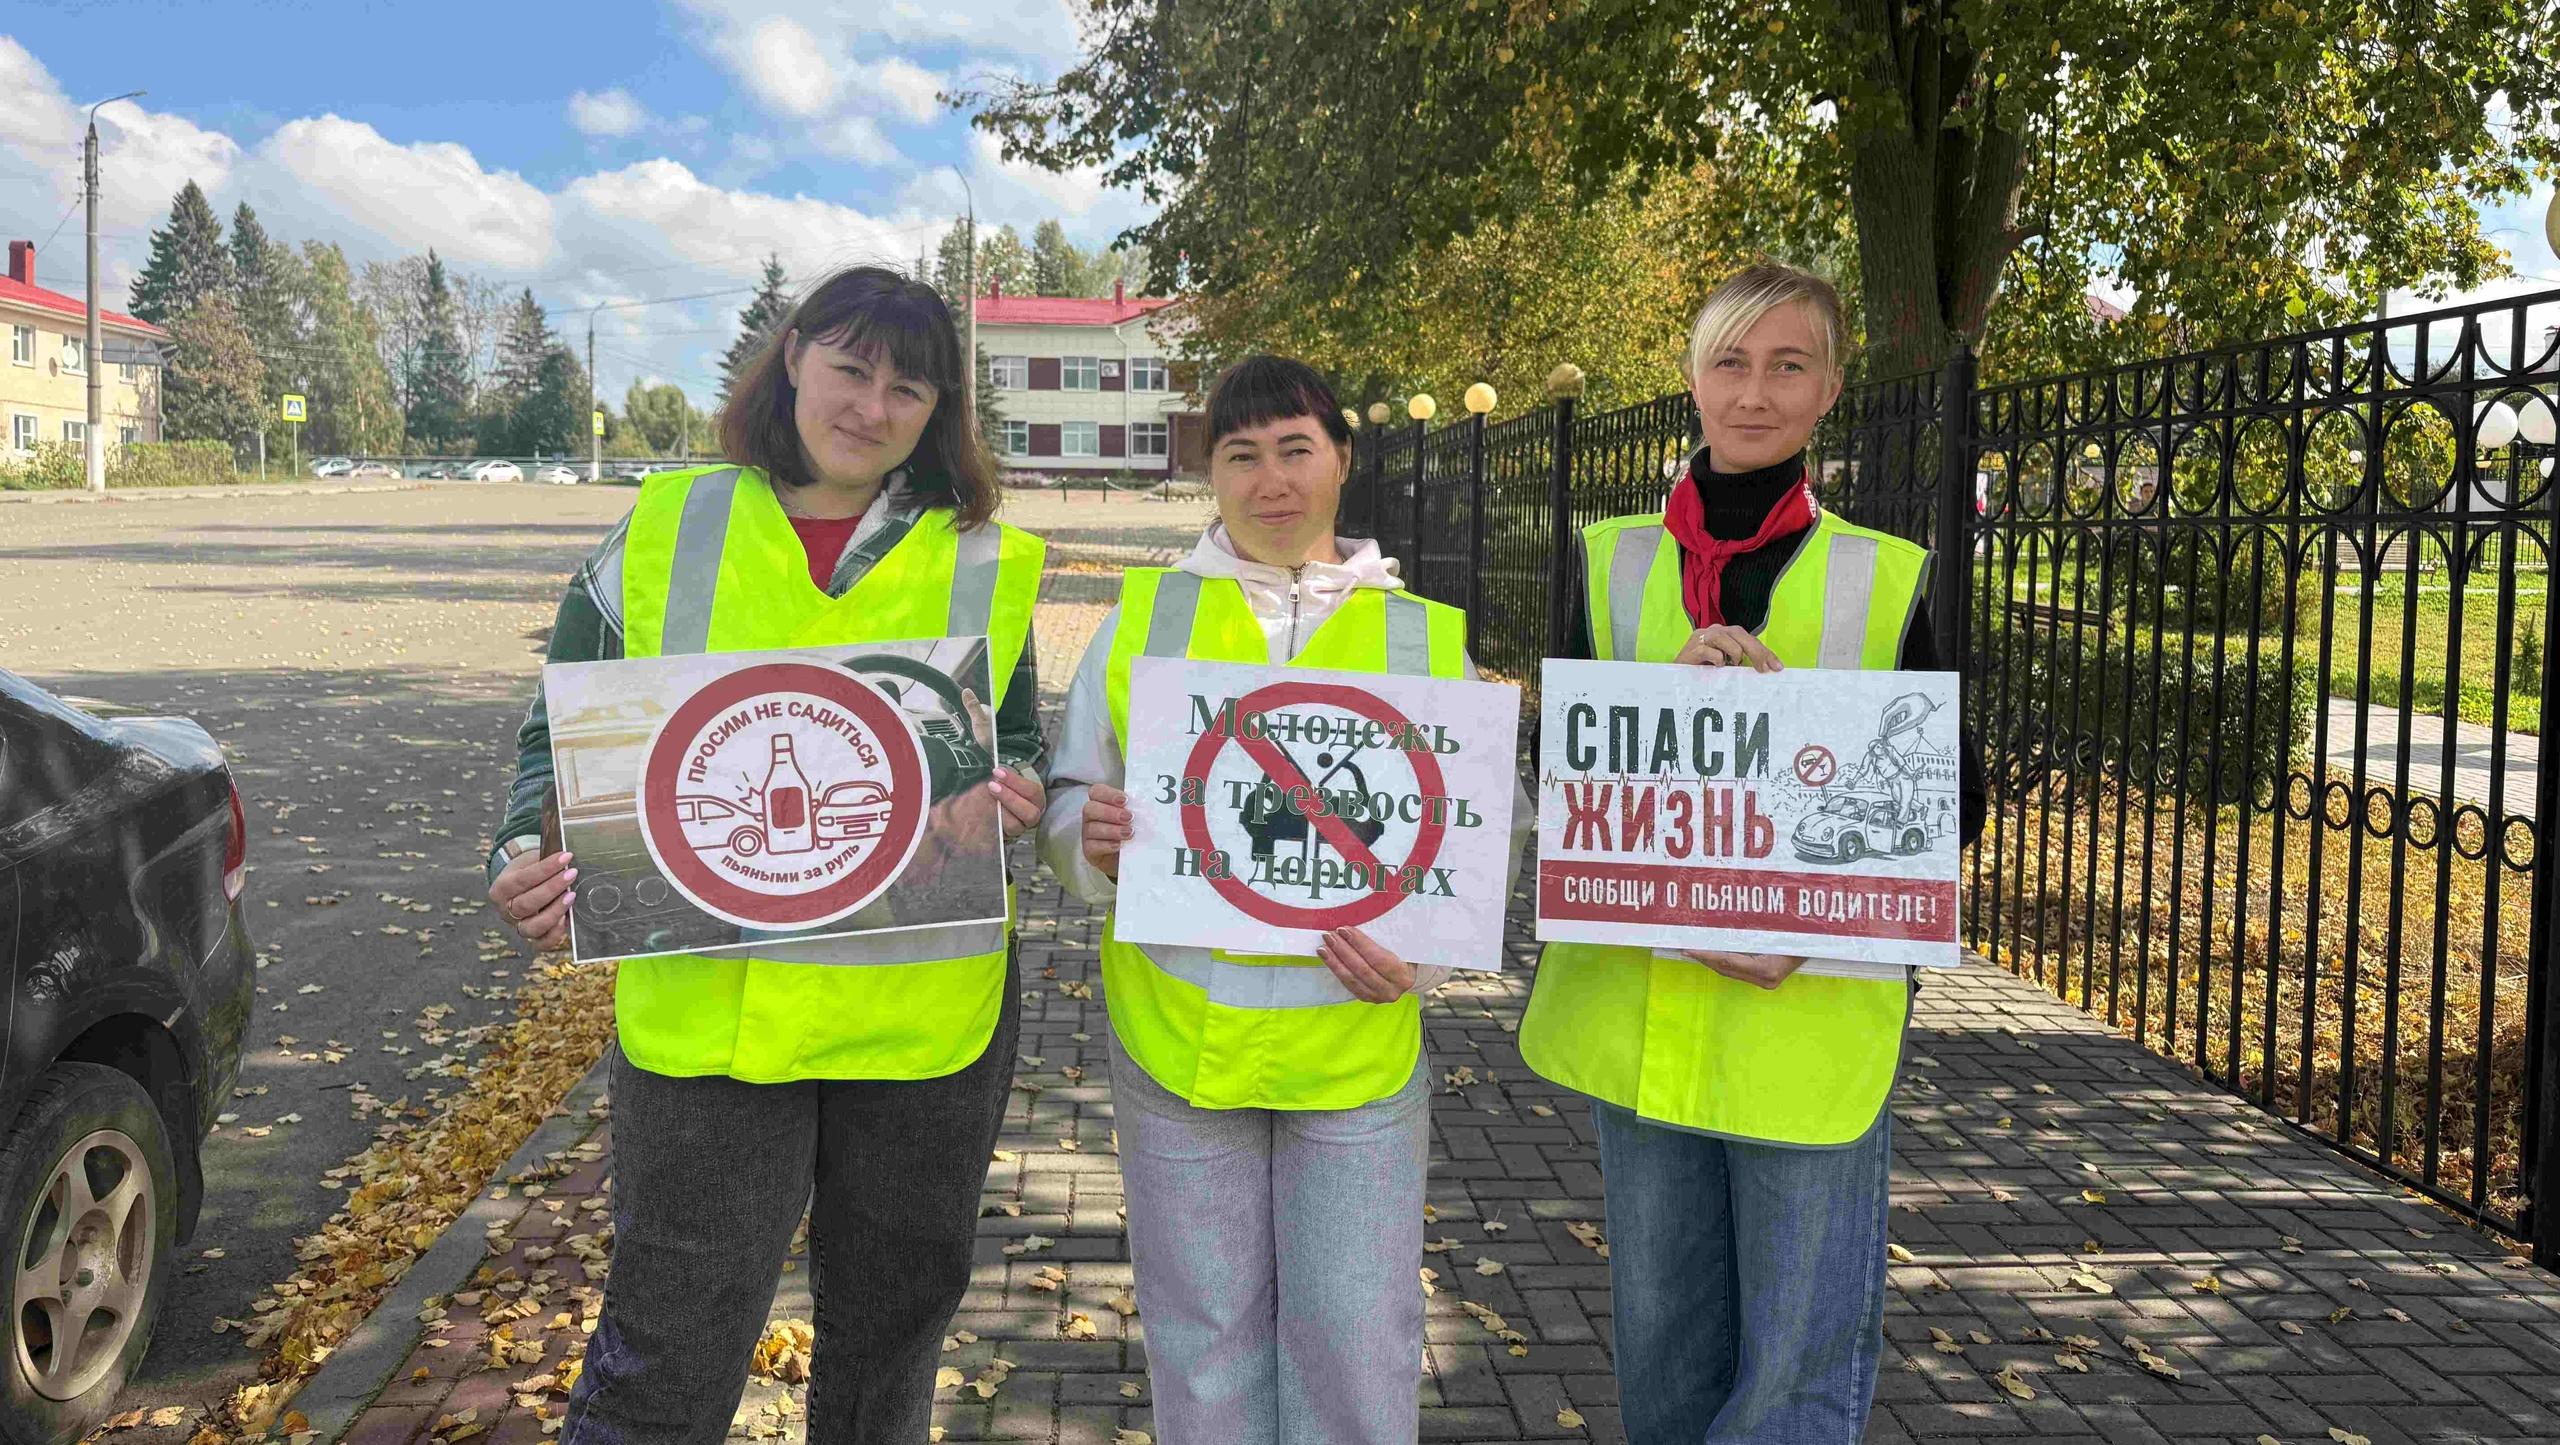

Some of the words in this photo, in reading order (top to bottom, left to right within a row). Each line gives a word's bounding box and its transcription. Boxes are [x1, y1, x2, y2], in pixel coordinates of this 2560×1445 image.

[688, 710, 752, 783] ПРОСИМ
[754, 701, 783, 720] НЕ
[788, 701, 879, 768] САДИТЬСЯ
[1185, 694, 1461, 755] Молодежь
[1566, 703, 1770, 779] СПАСИ
[1154, 773, 1206, 807] за
[1223, 779, 1483, 828] трезвость
[1562, 783, 1775, 860] ЖИЗНЬ
[721, 855, 799, 882] пьяными
[804, 867, 823, 880] за
[825, 844, 860, 875] руль
[1172, 846, 1232, 880] на
[1247, 853, 1457, 899] дорогах
[1564, 876, 1655, 911] СООБЩИ
[1666, 882, 1678, 907] О
[1691, 883, 1785, 914] ПЬЯНОМ
[1799, 889, 1937, 924] ВОДИТЕЛЕ!
